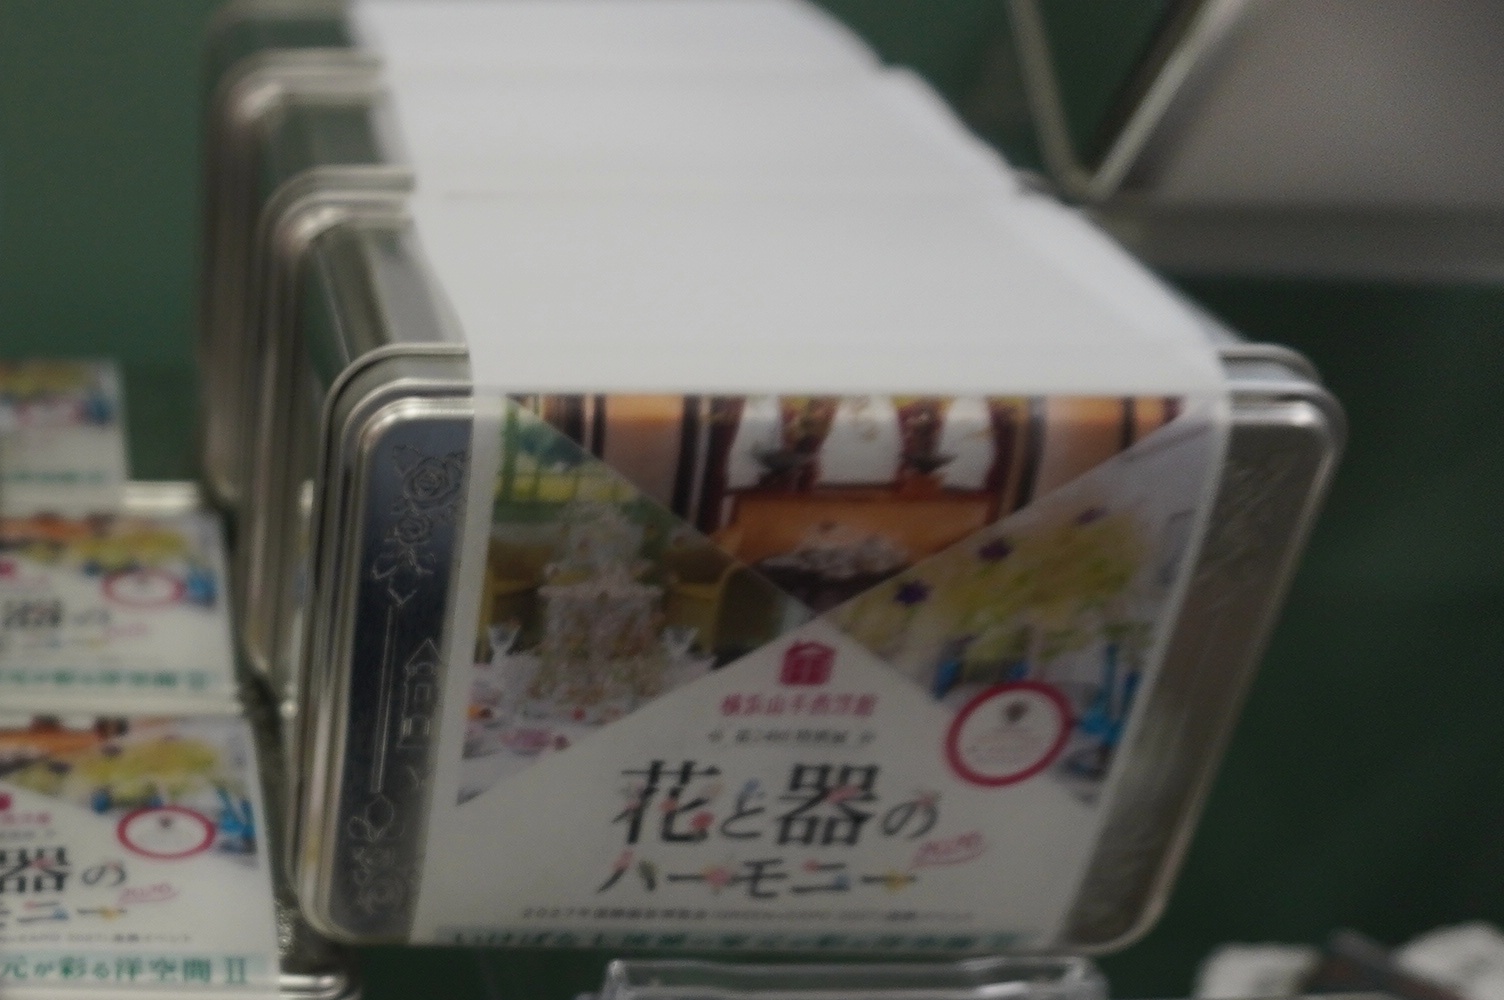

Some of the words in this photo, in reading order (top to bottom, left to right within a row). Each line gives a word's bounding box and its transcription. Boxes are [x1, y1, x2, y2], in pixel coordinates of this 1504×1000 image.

[612, 760, 941, 846] 花と器の
[597, 851, 917, 900] ハーモニー
